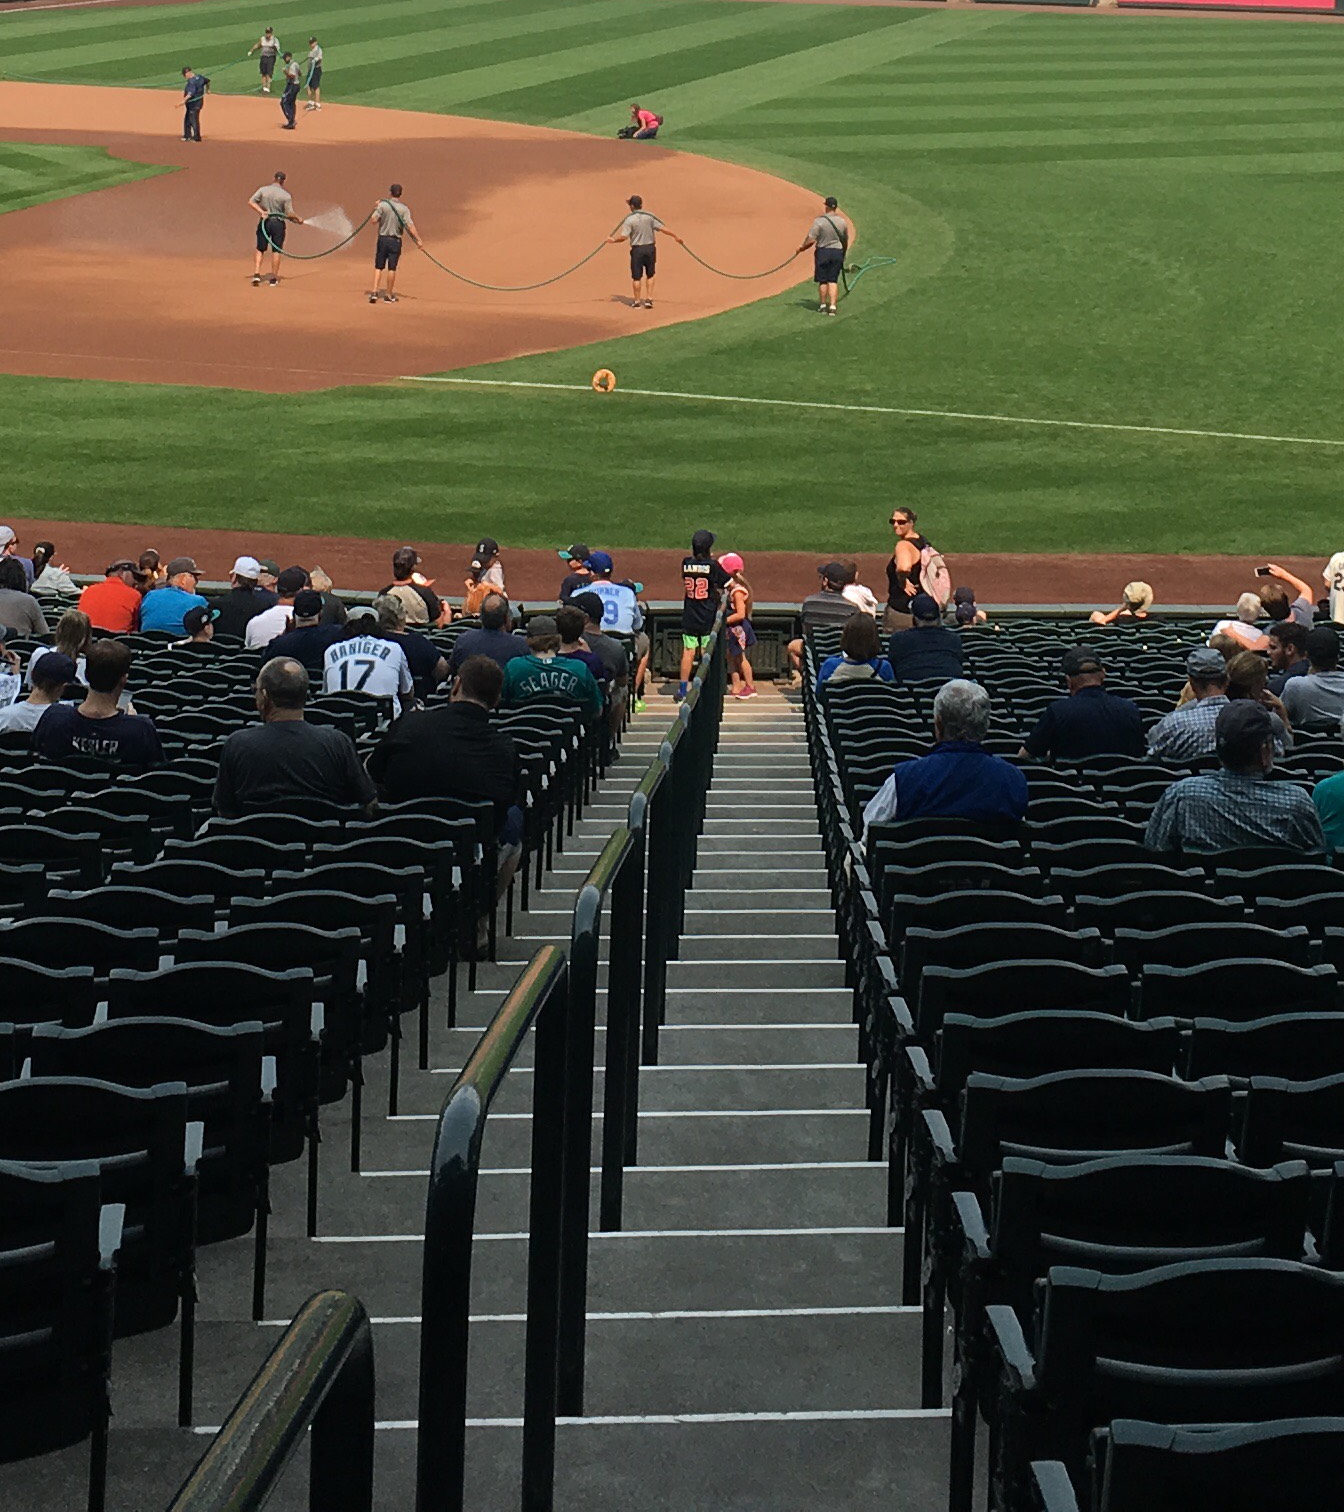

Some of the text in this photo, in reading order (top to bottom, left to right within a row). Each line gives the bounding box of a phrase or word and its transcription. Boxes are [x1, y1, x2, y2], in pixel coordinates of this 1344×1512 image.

[684, 576, 710, 600] 22
[330, 640, 392, 664] HANIGER
[338, 659, 376, 691] 17
[519, 671, 579, 696] SEAGER
